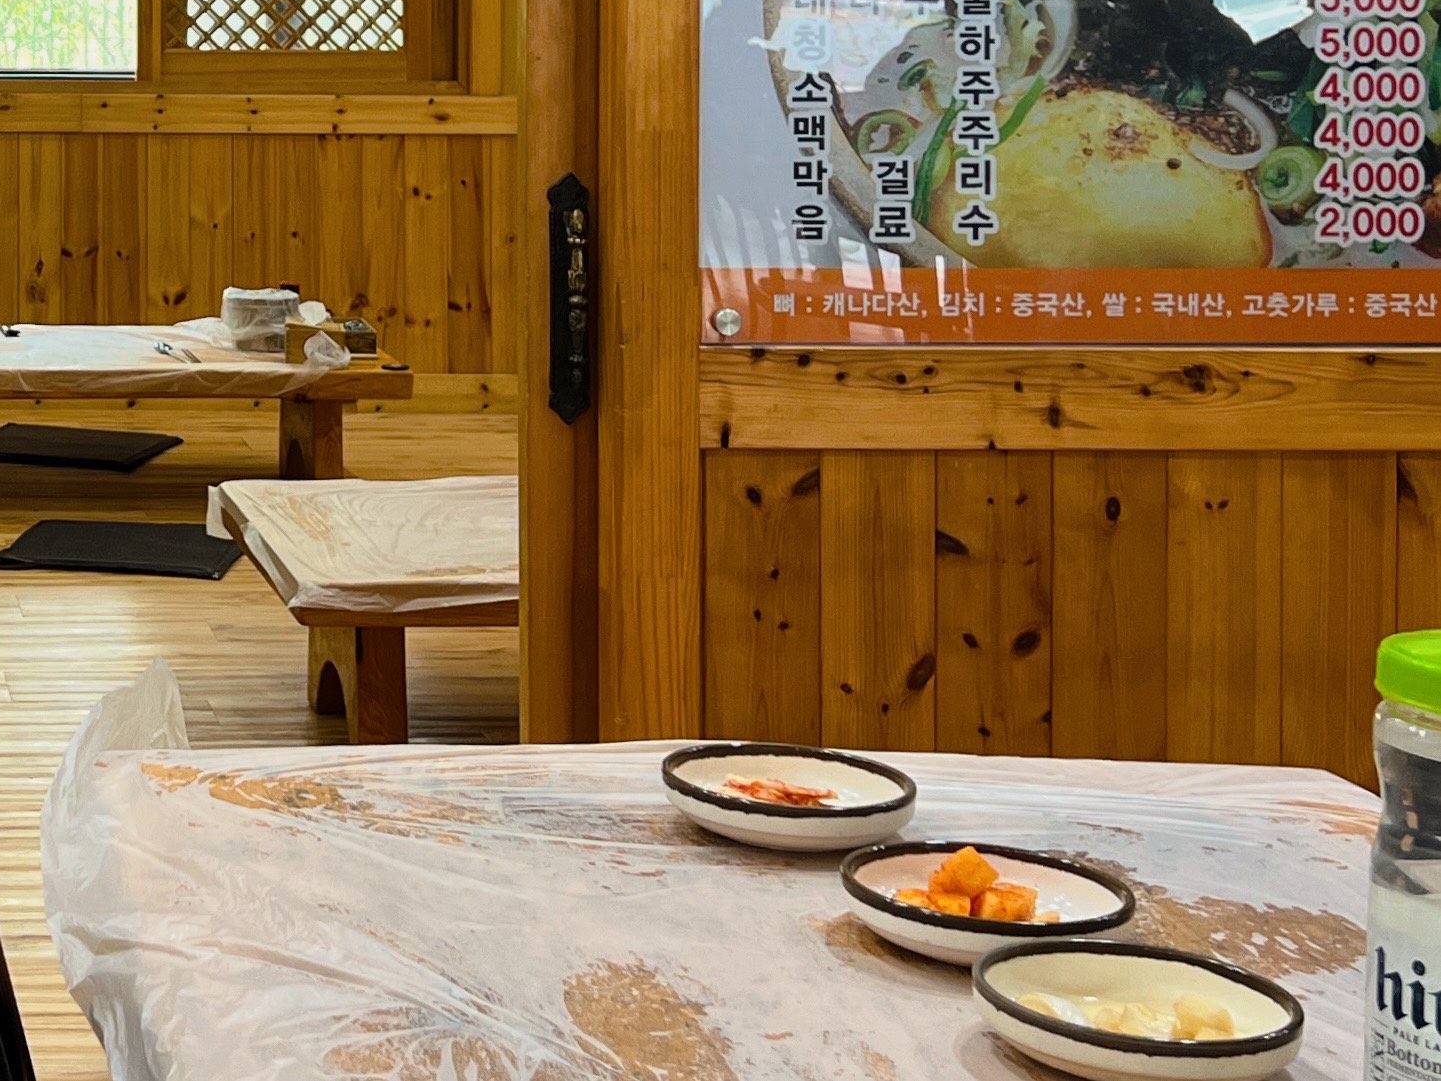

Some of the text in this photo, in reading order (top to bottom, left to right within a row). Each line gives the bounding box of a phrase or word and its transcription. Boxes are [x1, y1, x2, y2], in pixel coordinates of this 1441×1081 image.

[1320, 26, 1420, 61] 5,000
[1318, 72, 1420, 106] 4,000
[1318, 117, 1420, 151] 4,000
[1318, 162, 1420, 196] 4,000
[1318, 207, 1420, 242] 2,000
[823, 293, 928, 318] 캐나다산,
[942, 293, 985, 316] 김치
[1012, 293, 1092, 318] 중국산,
[1152, 293, 1232, 317] 국내산,
[1242, 293, 1339, 316] 고춧가루
[1364, 293, 1437, 317] 중국산
[1375, 945, 1441, 1036] hi
